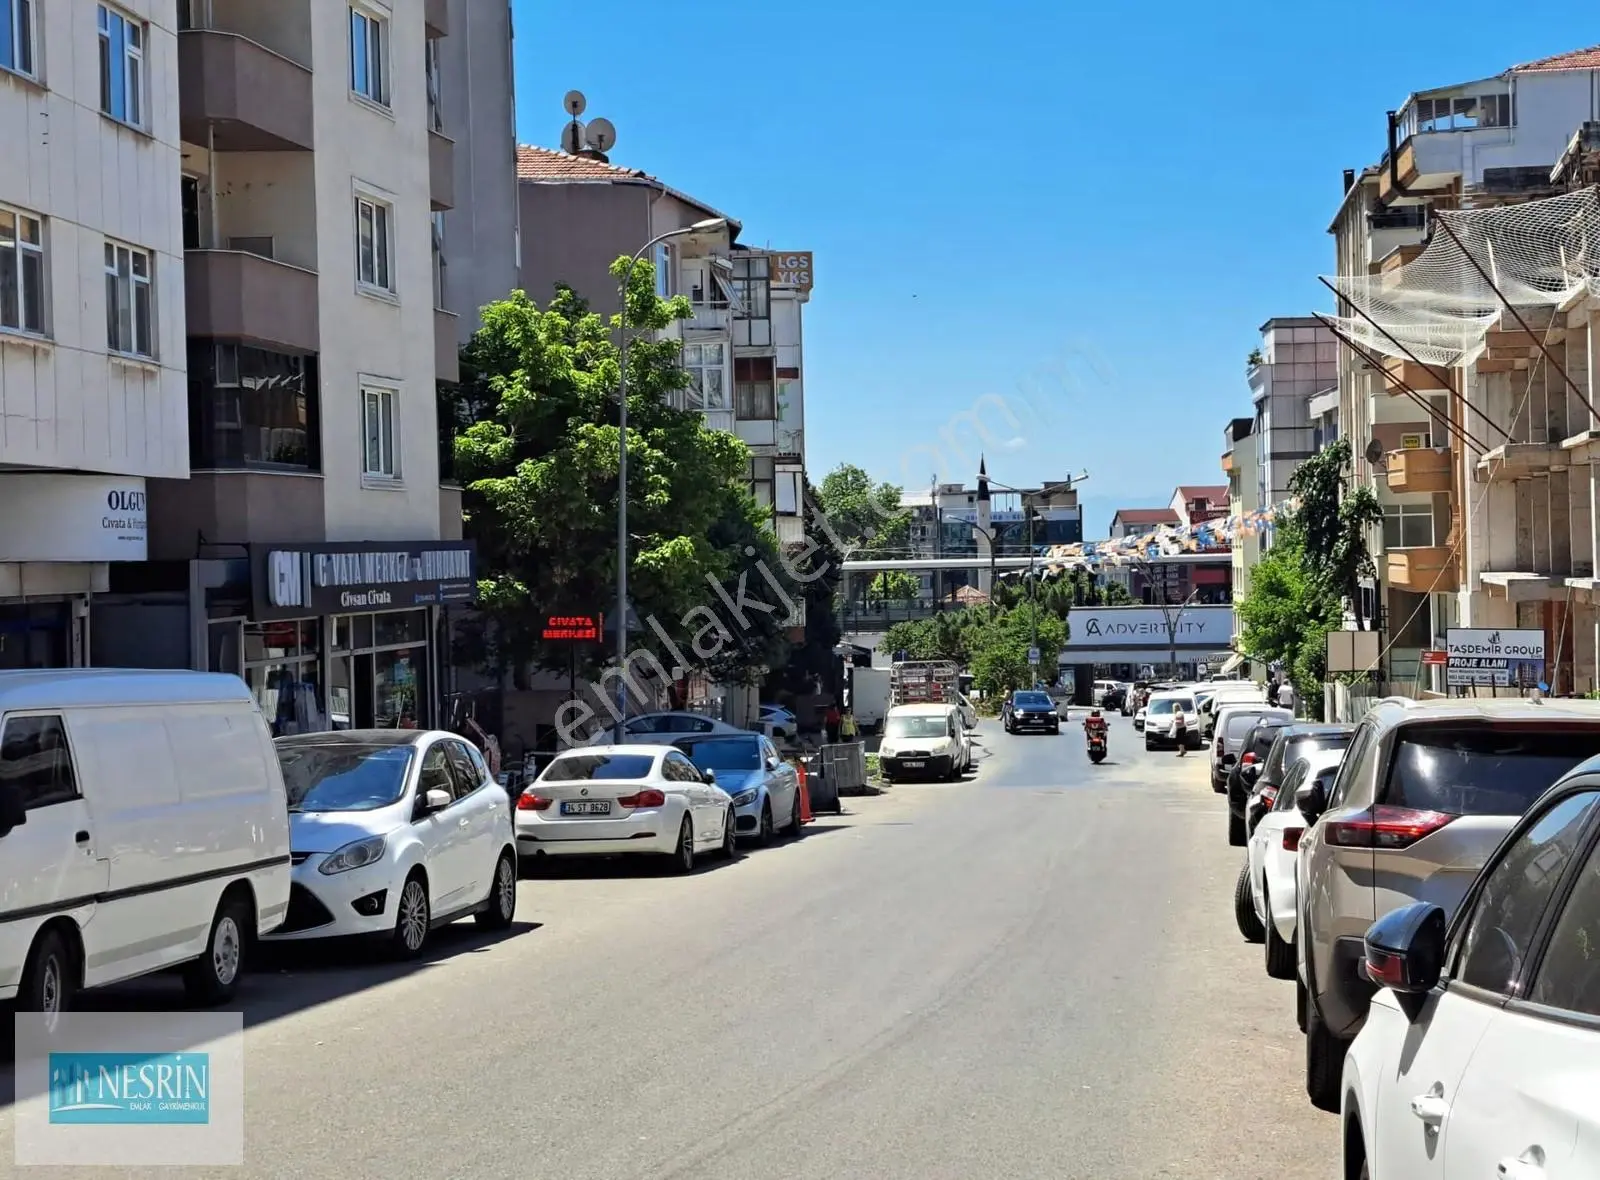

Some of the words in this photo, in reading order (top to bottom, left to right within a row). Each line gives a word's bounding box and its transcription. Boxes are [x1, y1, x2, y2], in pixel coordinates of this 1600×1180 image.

[778, 255, 808, 269] LGS
[777, 271, 809, 284] YKS
[1105, 622, 1206, 635] ADVERTITY
[1504, 646, 1543, 655] GROUP
[1449, 658, 1478, 667] PROJE
[1480, 659, 1507, 668] ALANI
